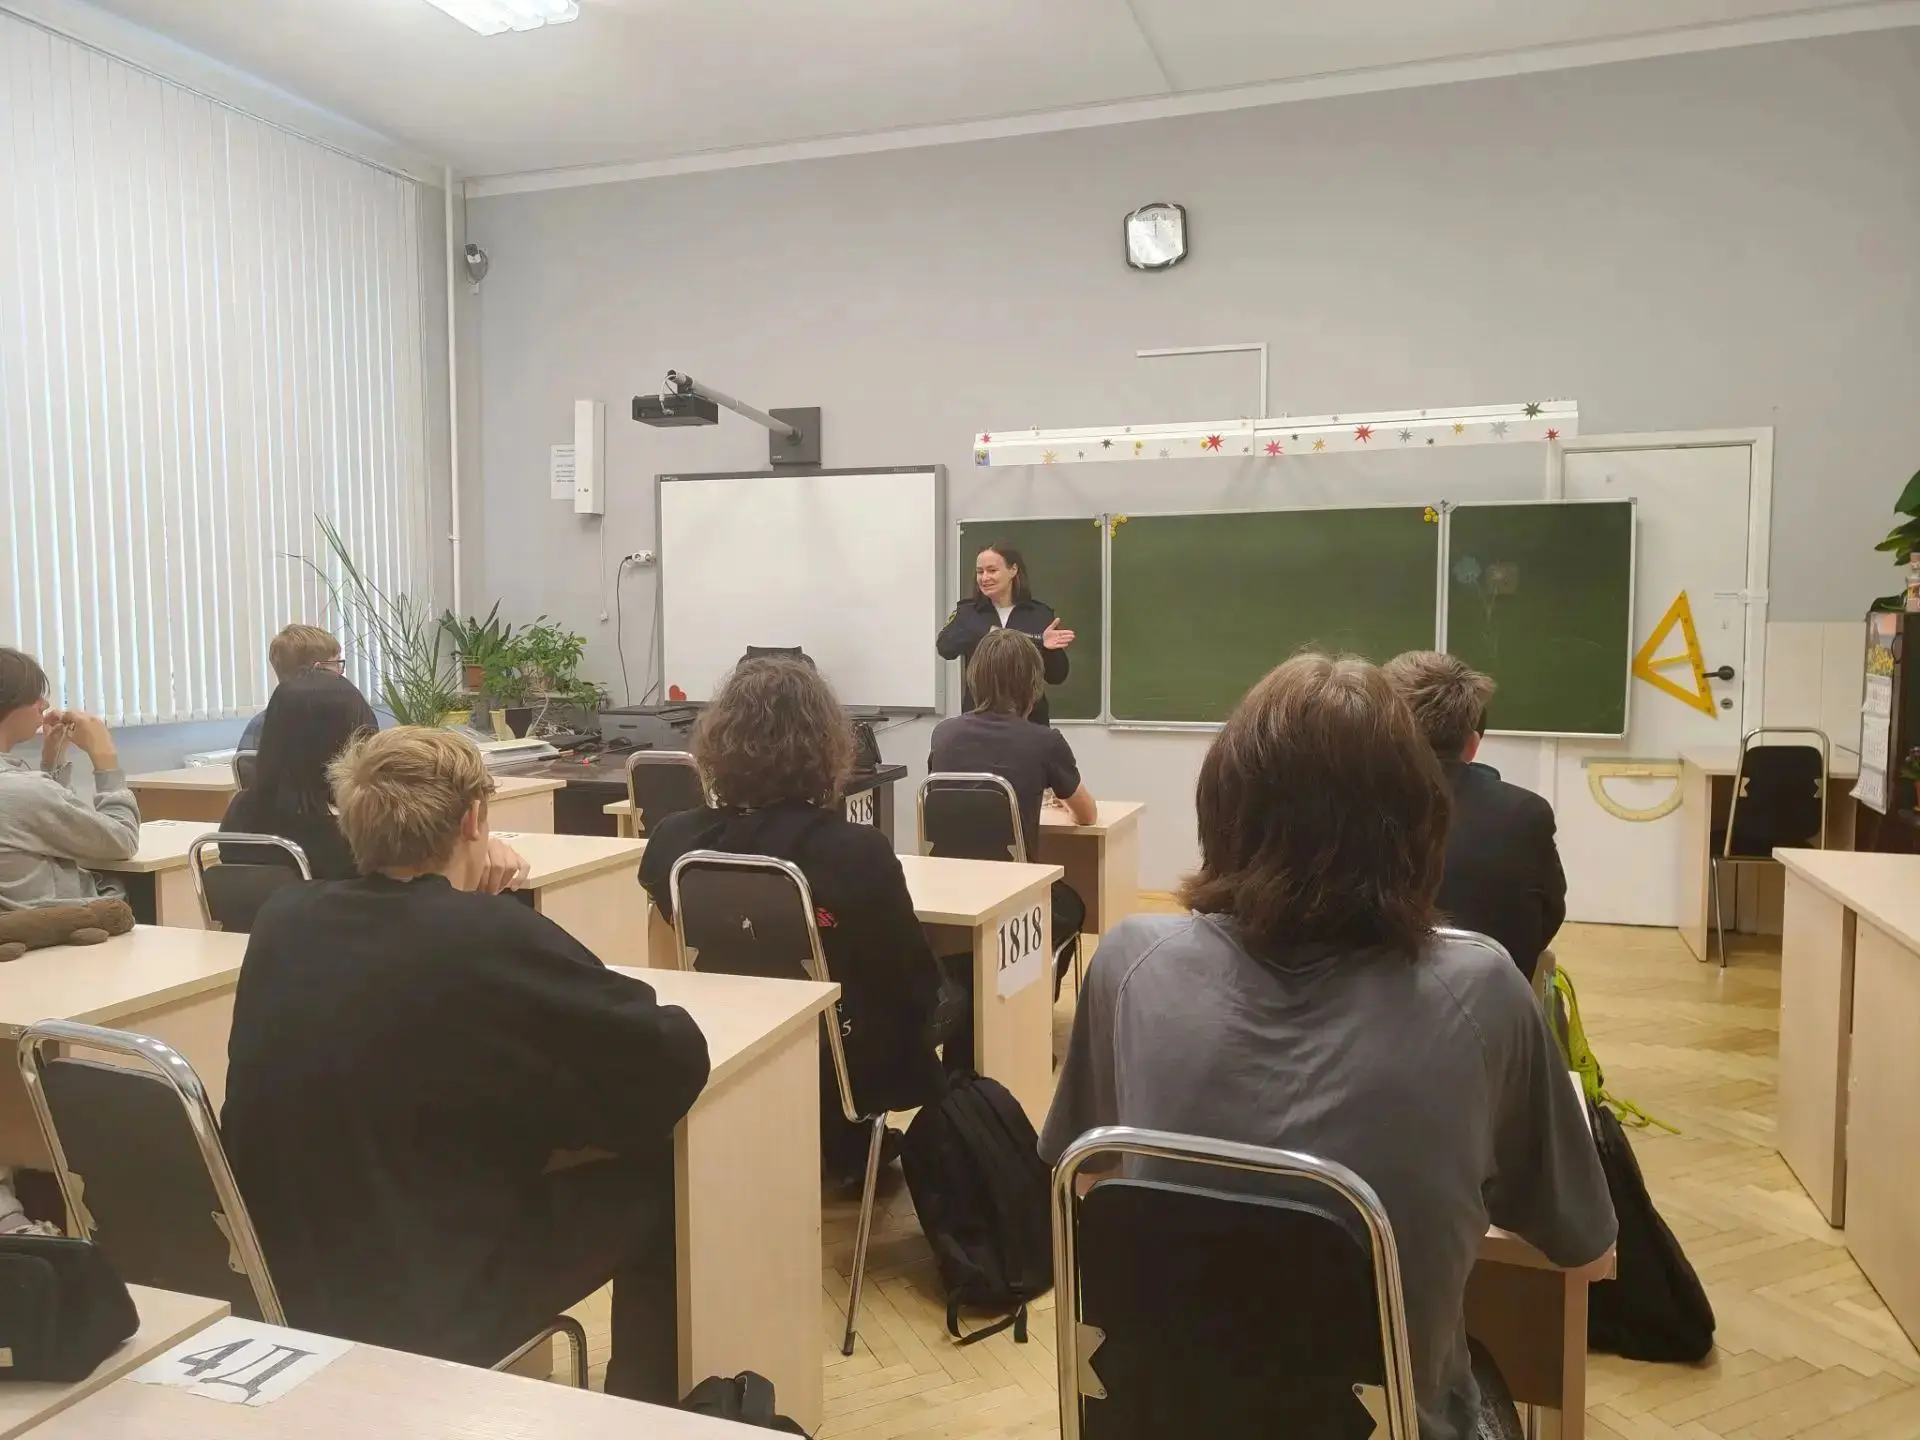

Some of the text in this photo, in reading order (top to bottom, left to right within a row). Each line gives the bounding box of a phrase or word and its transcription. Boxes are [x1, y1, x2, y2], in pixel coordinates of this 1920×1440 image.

[850, 794, 873, 823] 818
[999, 906, 1042, 972] 1818
[177, 1338, 320, 1405] 4Д
